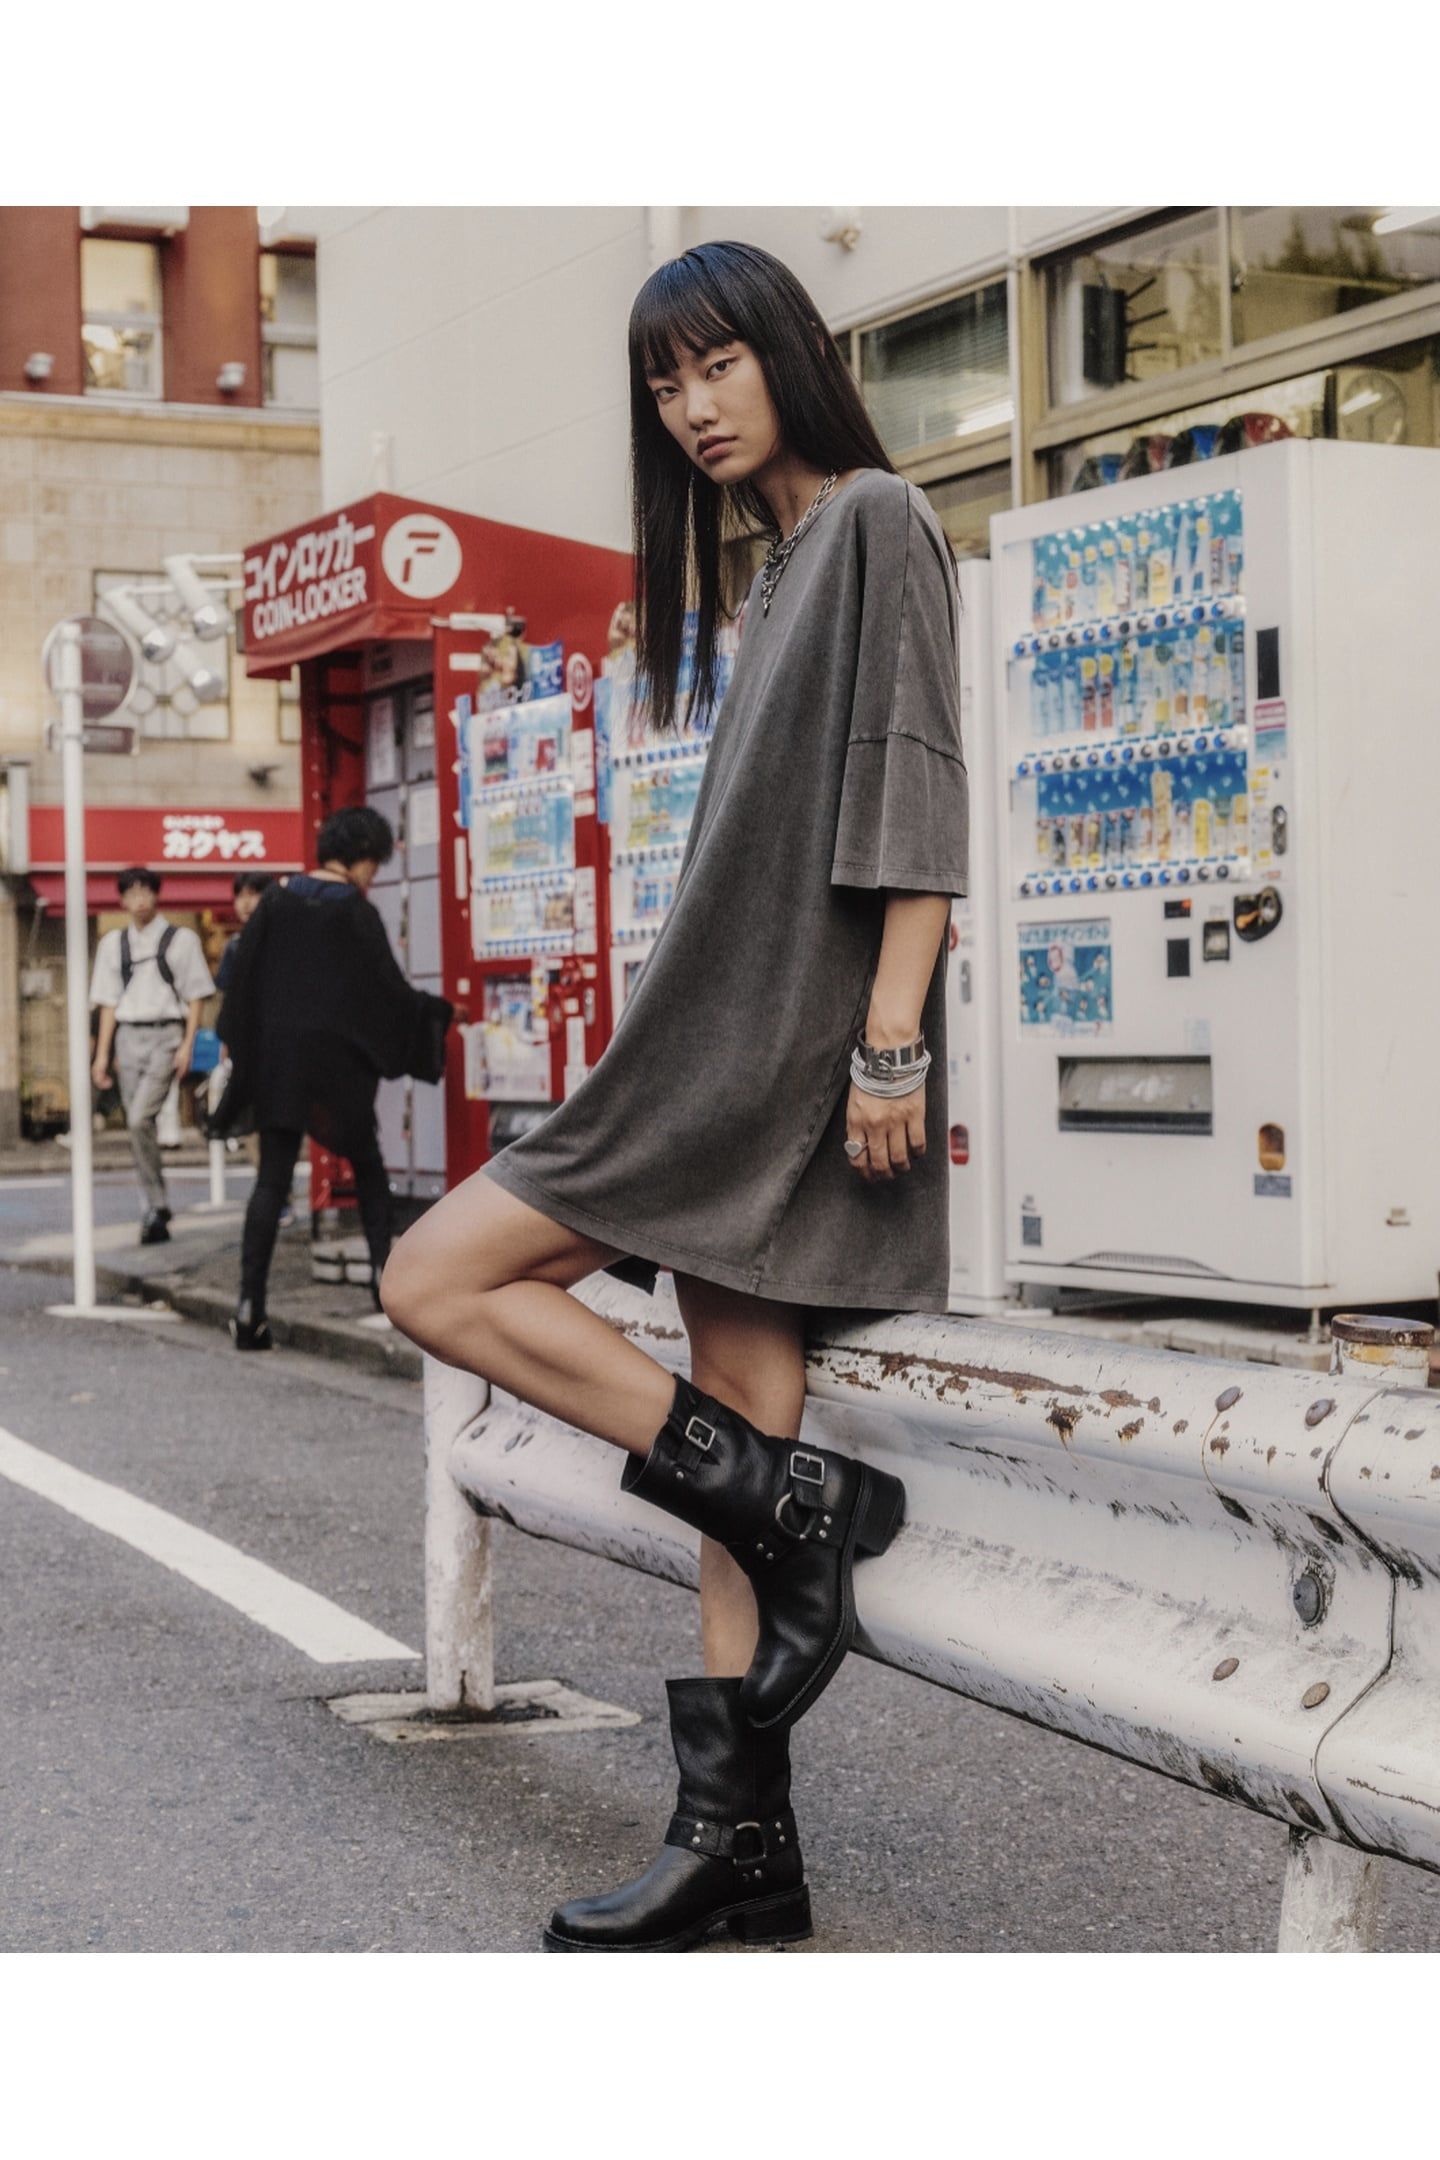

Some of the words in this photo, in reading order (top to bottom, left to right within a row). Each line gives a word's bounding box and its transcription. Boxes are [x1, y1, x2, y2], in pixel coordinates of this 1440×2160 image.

[245, 514, 376, 600] コインロッカー
[252, 567, 367, 639] COIN-LOCKER
[162, 829, 267, 859] カクヤス
